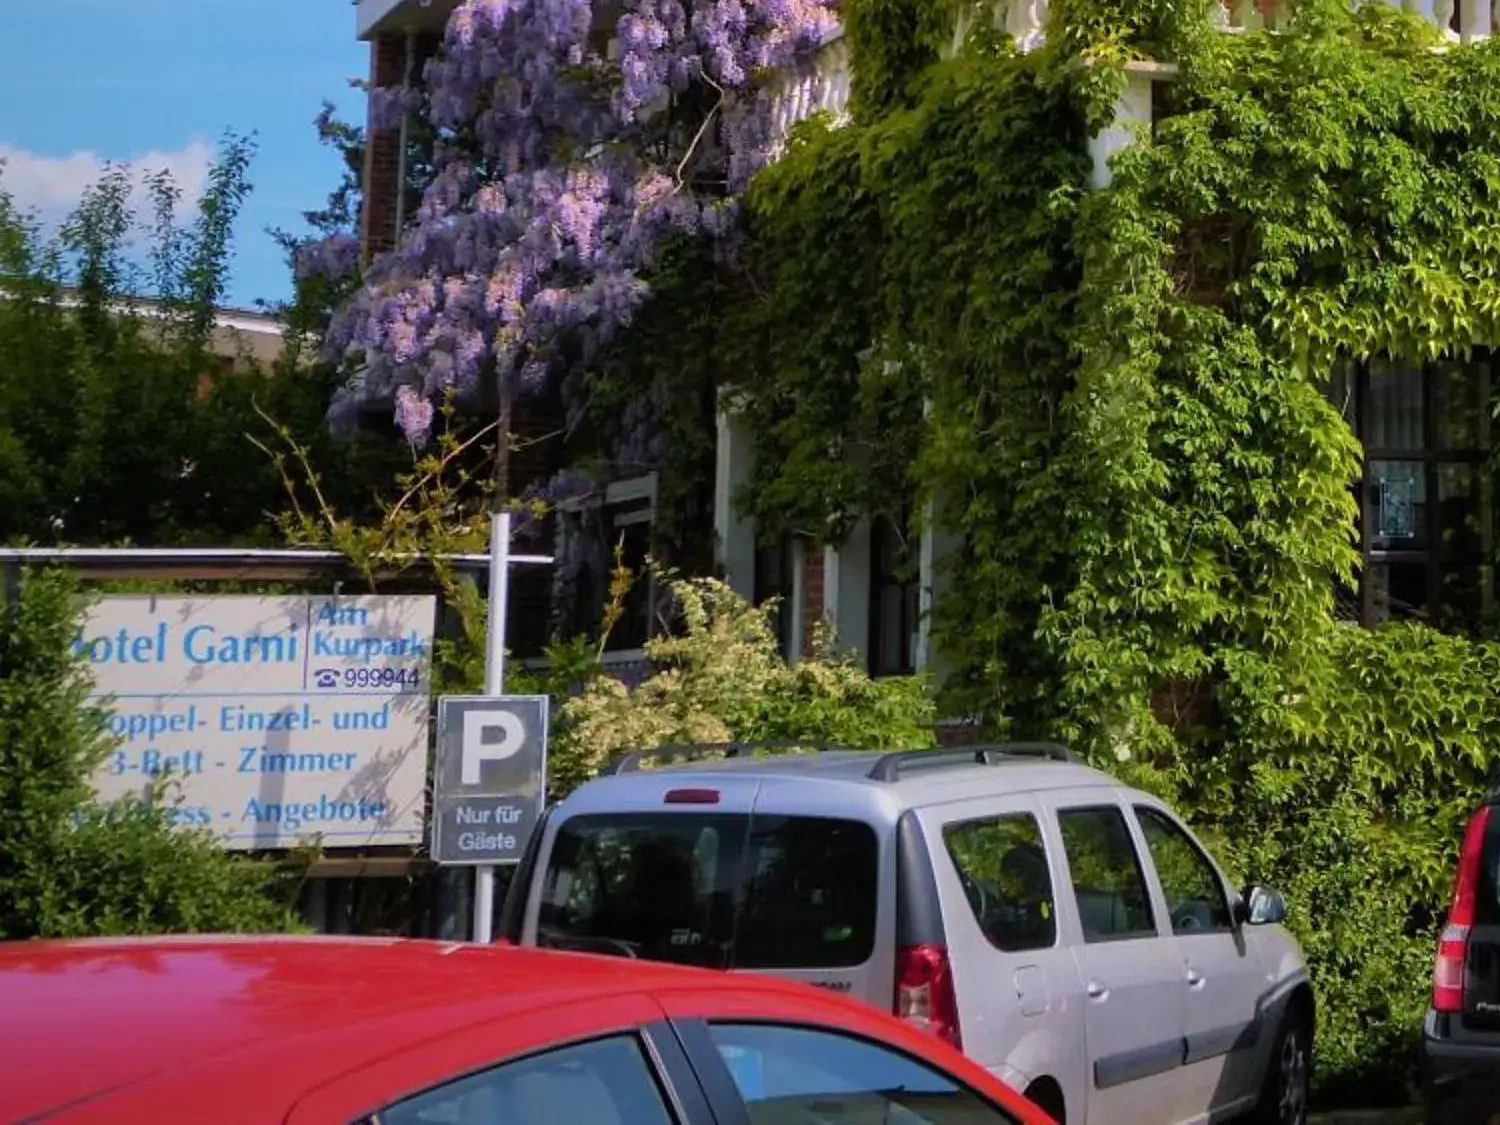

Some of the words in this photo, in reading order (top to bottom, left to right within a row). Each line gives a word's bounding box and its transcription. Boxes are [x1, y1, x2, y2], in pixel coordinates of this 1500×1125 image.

[318, 602, 367, 626] Am
[72, 622, 167, 664] otel
[183, 623, 297, 664] Garni
[315, 629, 426, 665] Kurpark
[344, 667, 419, 689] 999944
[85, 704, 207, 742] oppel-
[220, 703, 320, 732] Einzel-
[334, 702, 389, 730] und
[110, 748, 204, 775] 3-Bett
[236, 746, 357, 774] Zimmer
[461, 710, 526, 786] P
[241, 794, 387, 831] Angebote
[456, 806, 491, 824] Nur
[496, 805, 523, 823] für
[458, 832, 516, 851] Gäste
